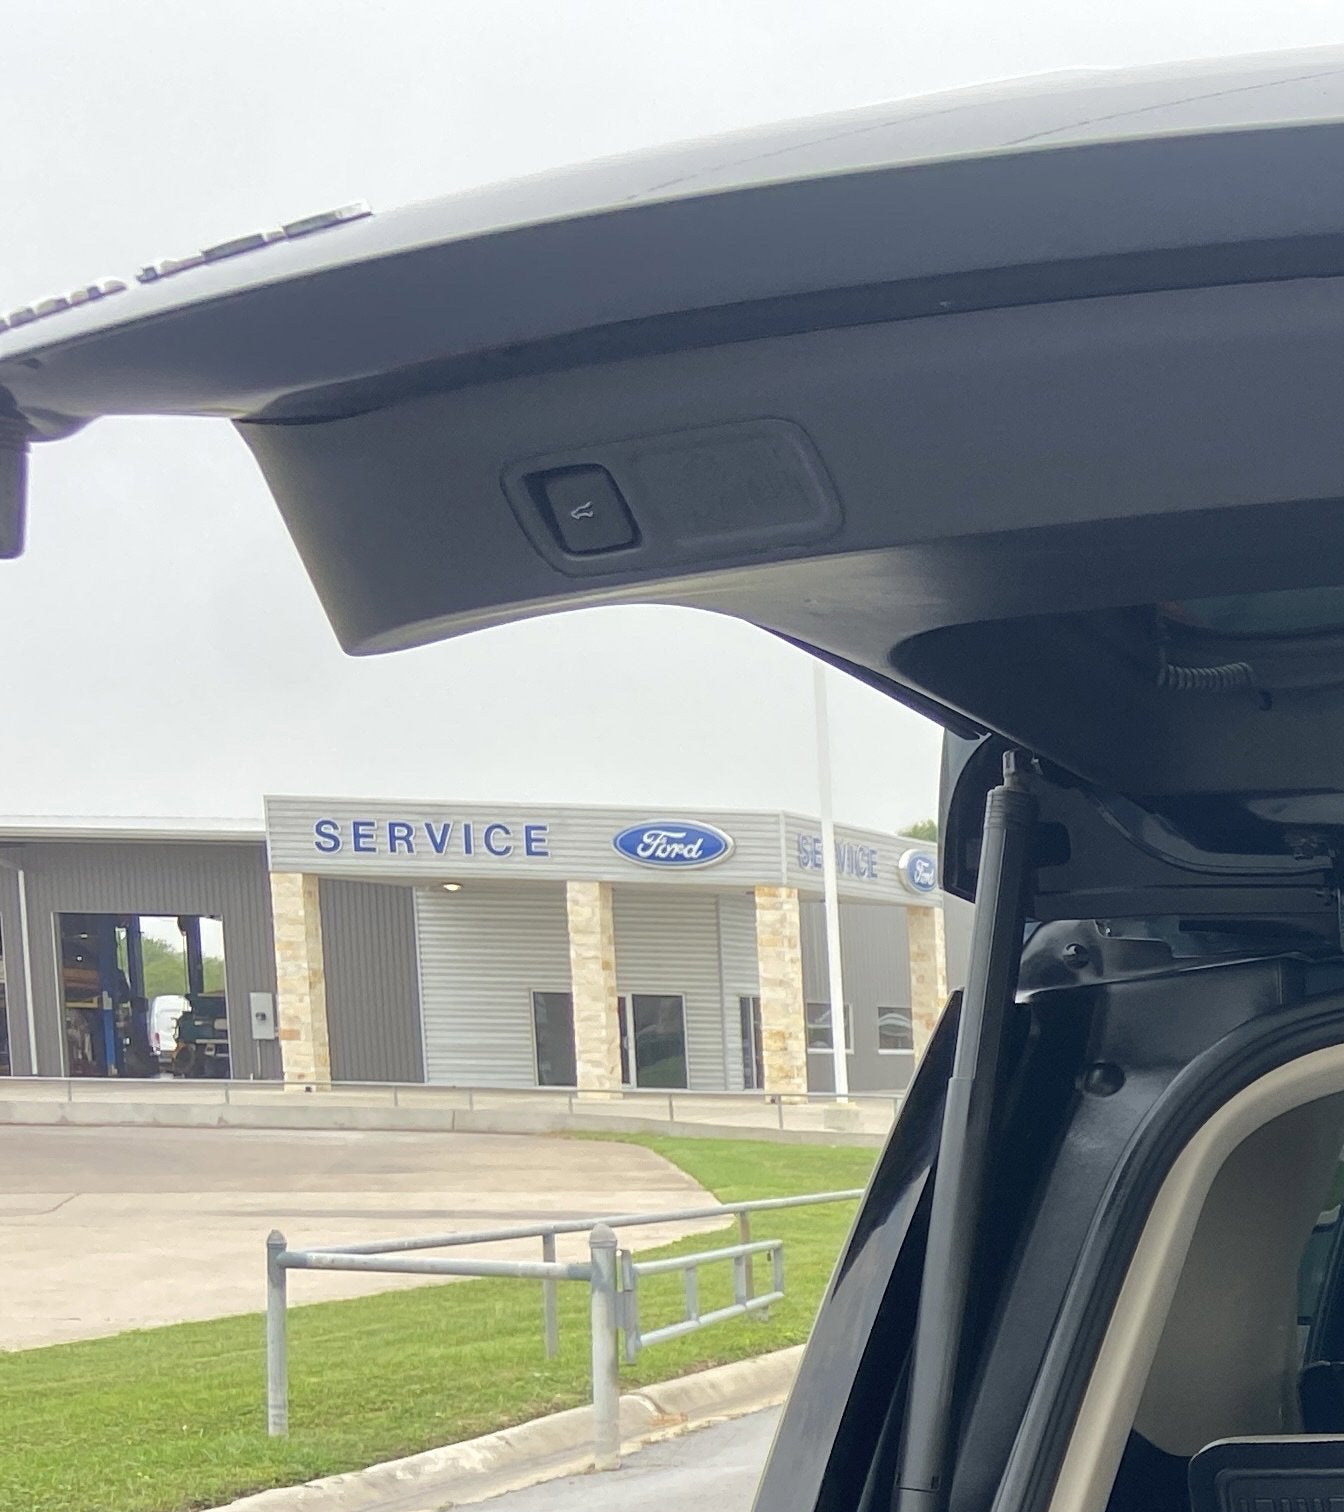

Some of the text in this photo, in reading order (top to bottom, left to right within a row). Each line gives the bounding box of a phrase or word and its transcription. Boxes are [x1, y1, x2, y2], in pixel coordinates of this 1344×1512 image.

[314, 819, 550, 857] SERVICE
[636, 829, 704, 859] Ford
[798, 833, 879, 879] SEVICE
